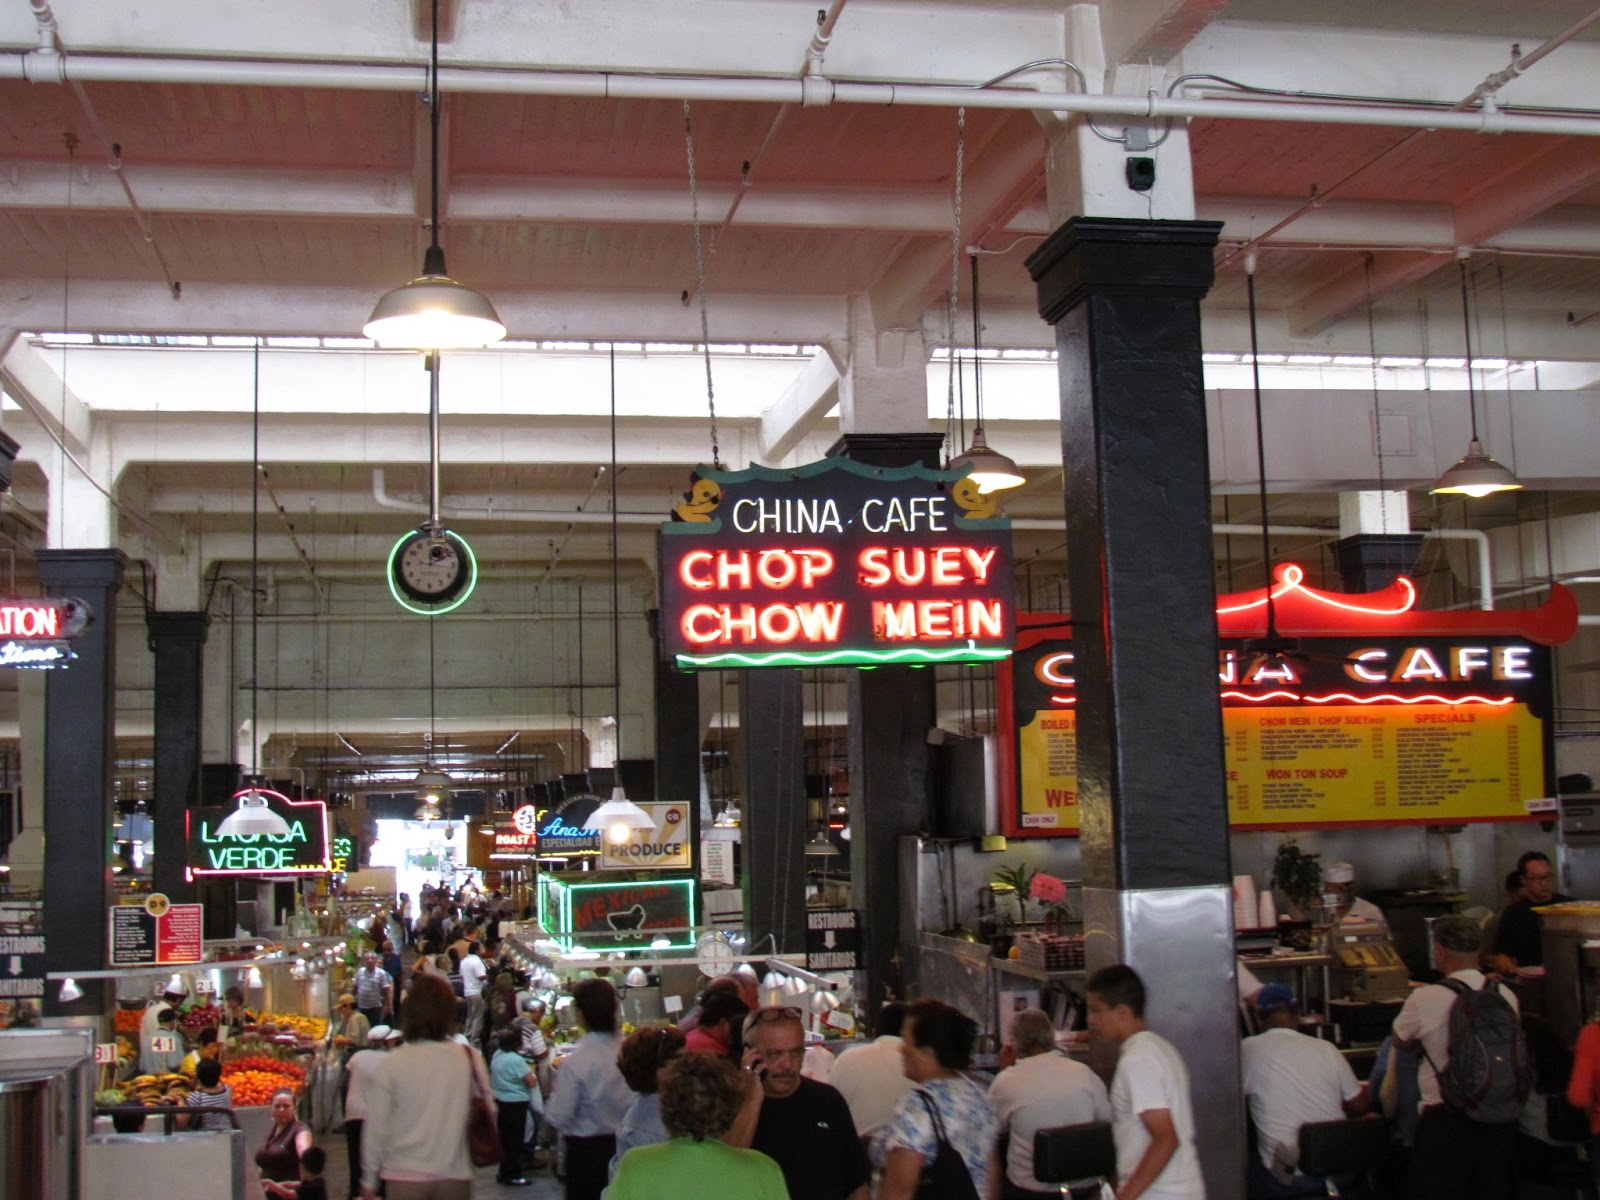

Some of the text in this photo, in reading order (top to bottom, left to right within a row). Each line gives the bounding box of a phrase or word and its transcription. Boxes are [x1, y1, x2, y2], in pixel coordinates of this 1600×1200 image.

[733, 497, 947, 533] CHINA CAFE
[680, 547, 997, 590] CHOP SUEY
[681, 600, 1002, 643] CHOW MEIN
[1344, 647, 1533, 682] CAFE
[1040, 720, 1069, 730] BOILED
[1260, 717, 1287, 726] CHOW
[1290, 717, 1310, 726] MEIN
[1318, 716, 1342, 725] CHOP
[1345, 716, 1368, 725] SUEY
[1415, 713, 1476, 724] SPECIALS
[1266, 768, 1348, 780] WON TON SOUP
[496, 834, 530, 845] ROAST
[610, 843, 681, 857] PRODUCE
[209, 848, 296, 870] VERDE
[808, 912, 856, 930] RESTROOMS
[809, 952, 856, 969] SANITARIOS
